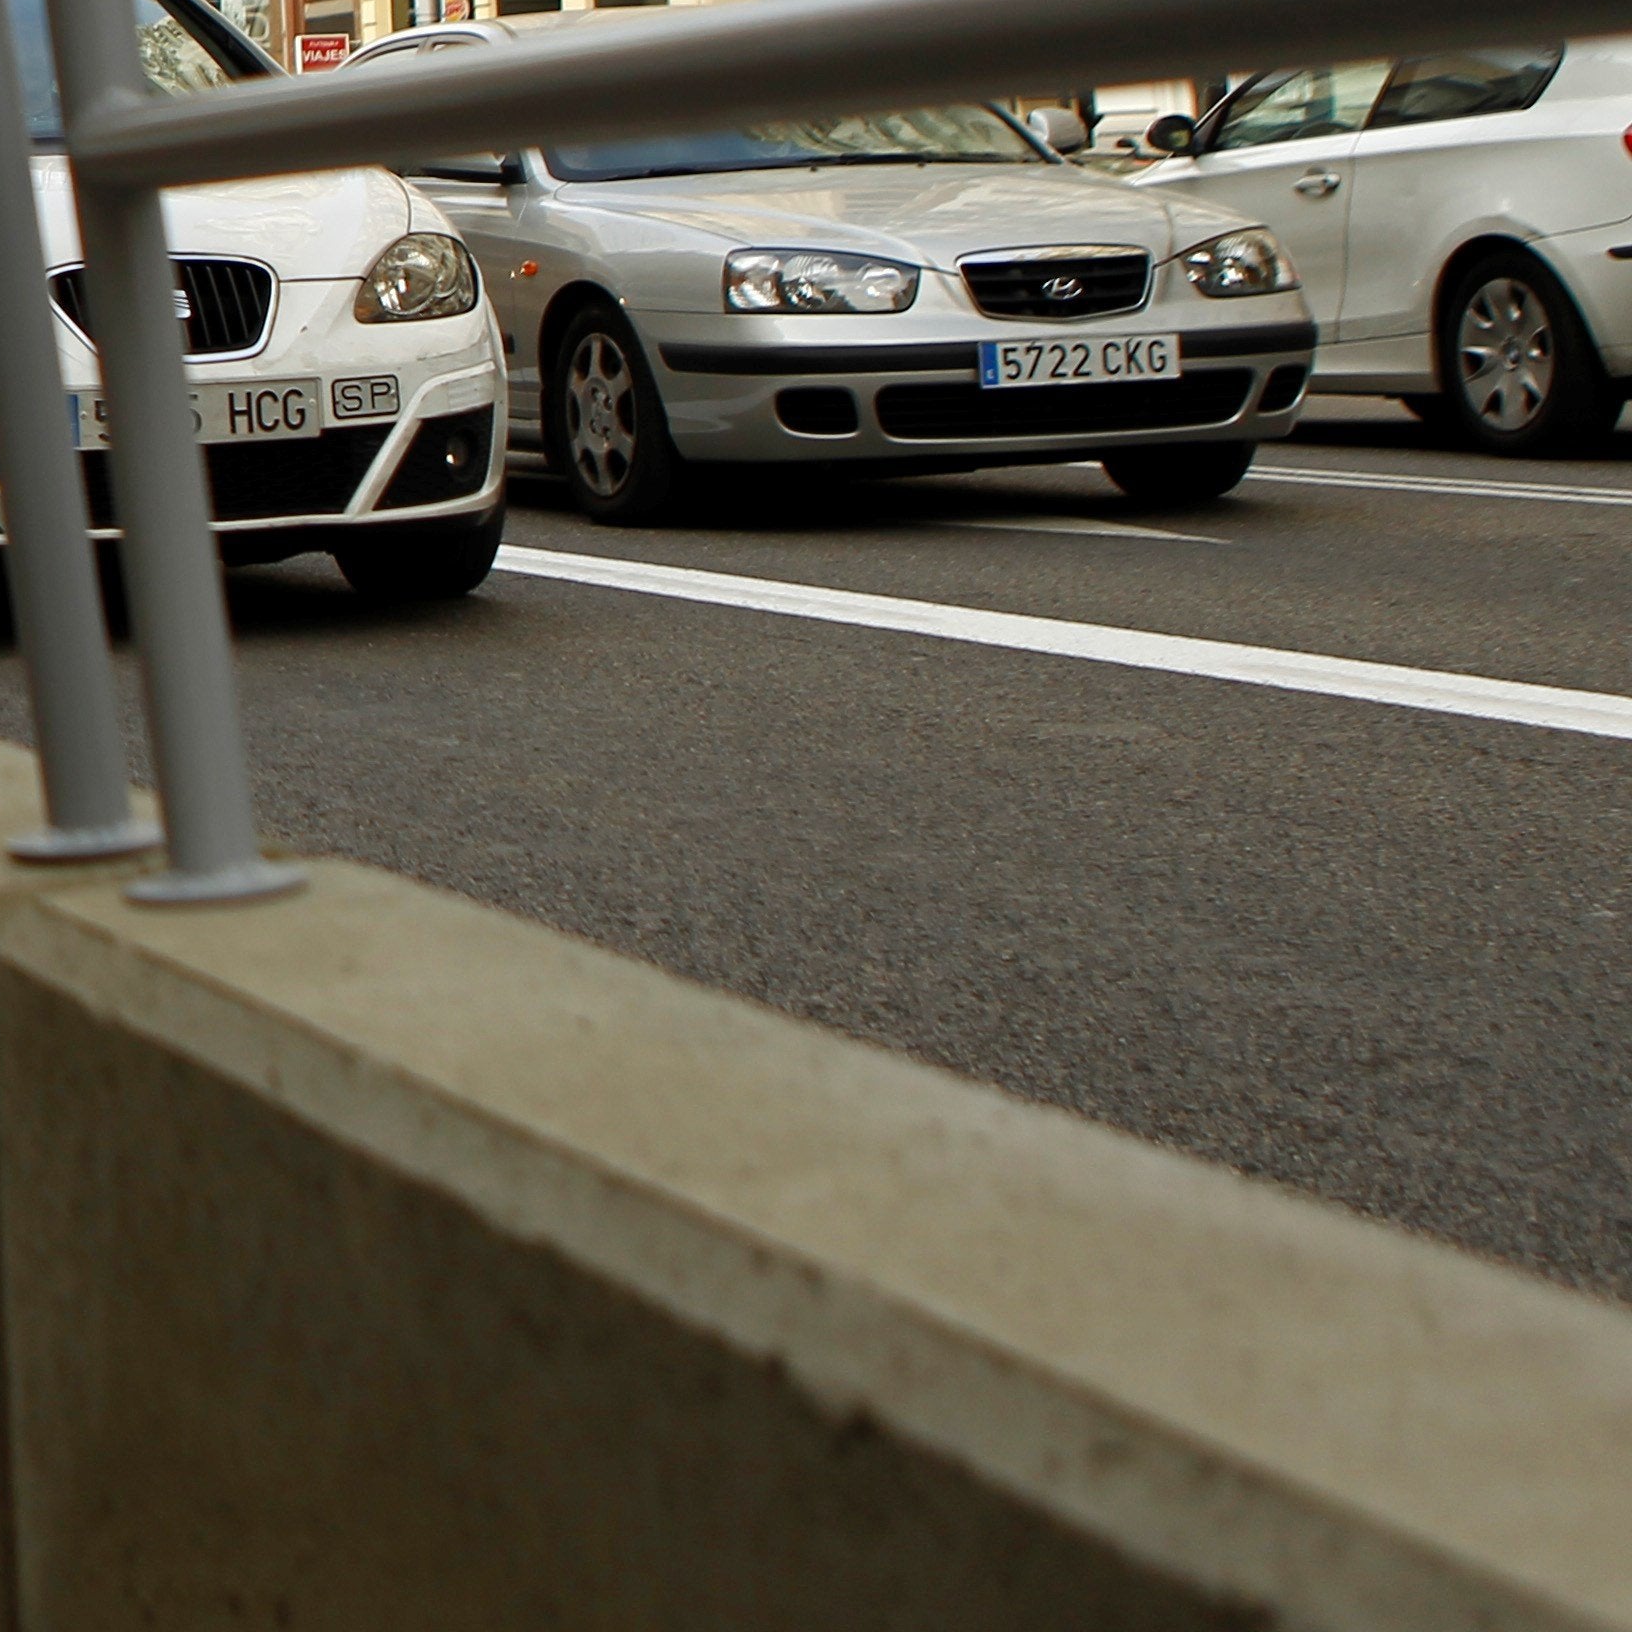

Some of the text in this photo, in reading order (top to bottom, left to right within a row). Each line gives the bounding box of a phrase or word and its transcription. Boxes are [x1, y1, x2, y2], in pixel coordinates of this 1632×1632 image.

[303, 49, 344, 62] VIAJES
[1003, 338, 1166, 380] 5722 CKG
[228, 387, 305, 434] HCG
[341, 381, 392, 412] SP
